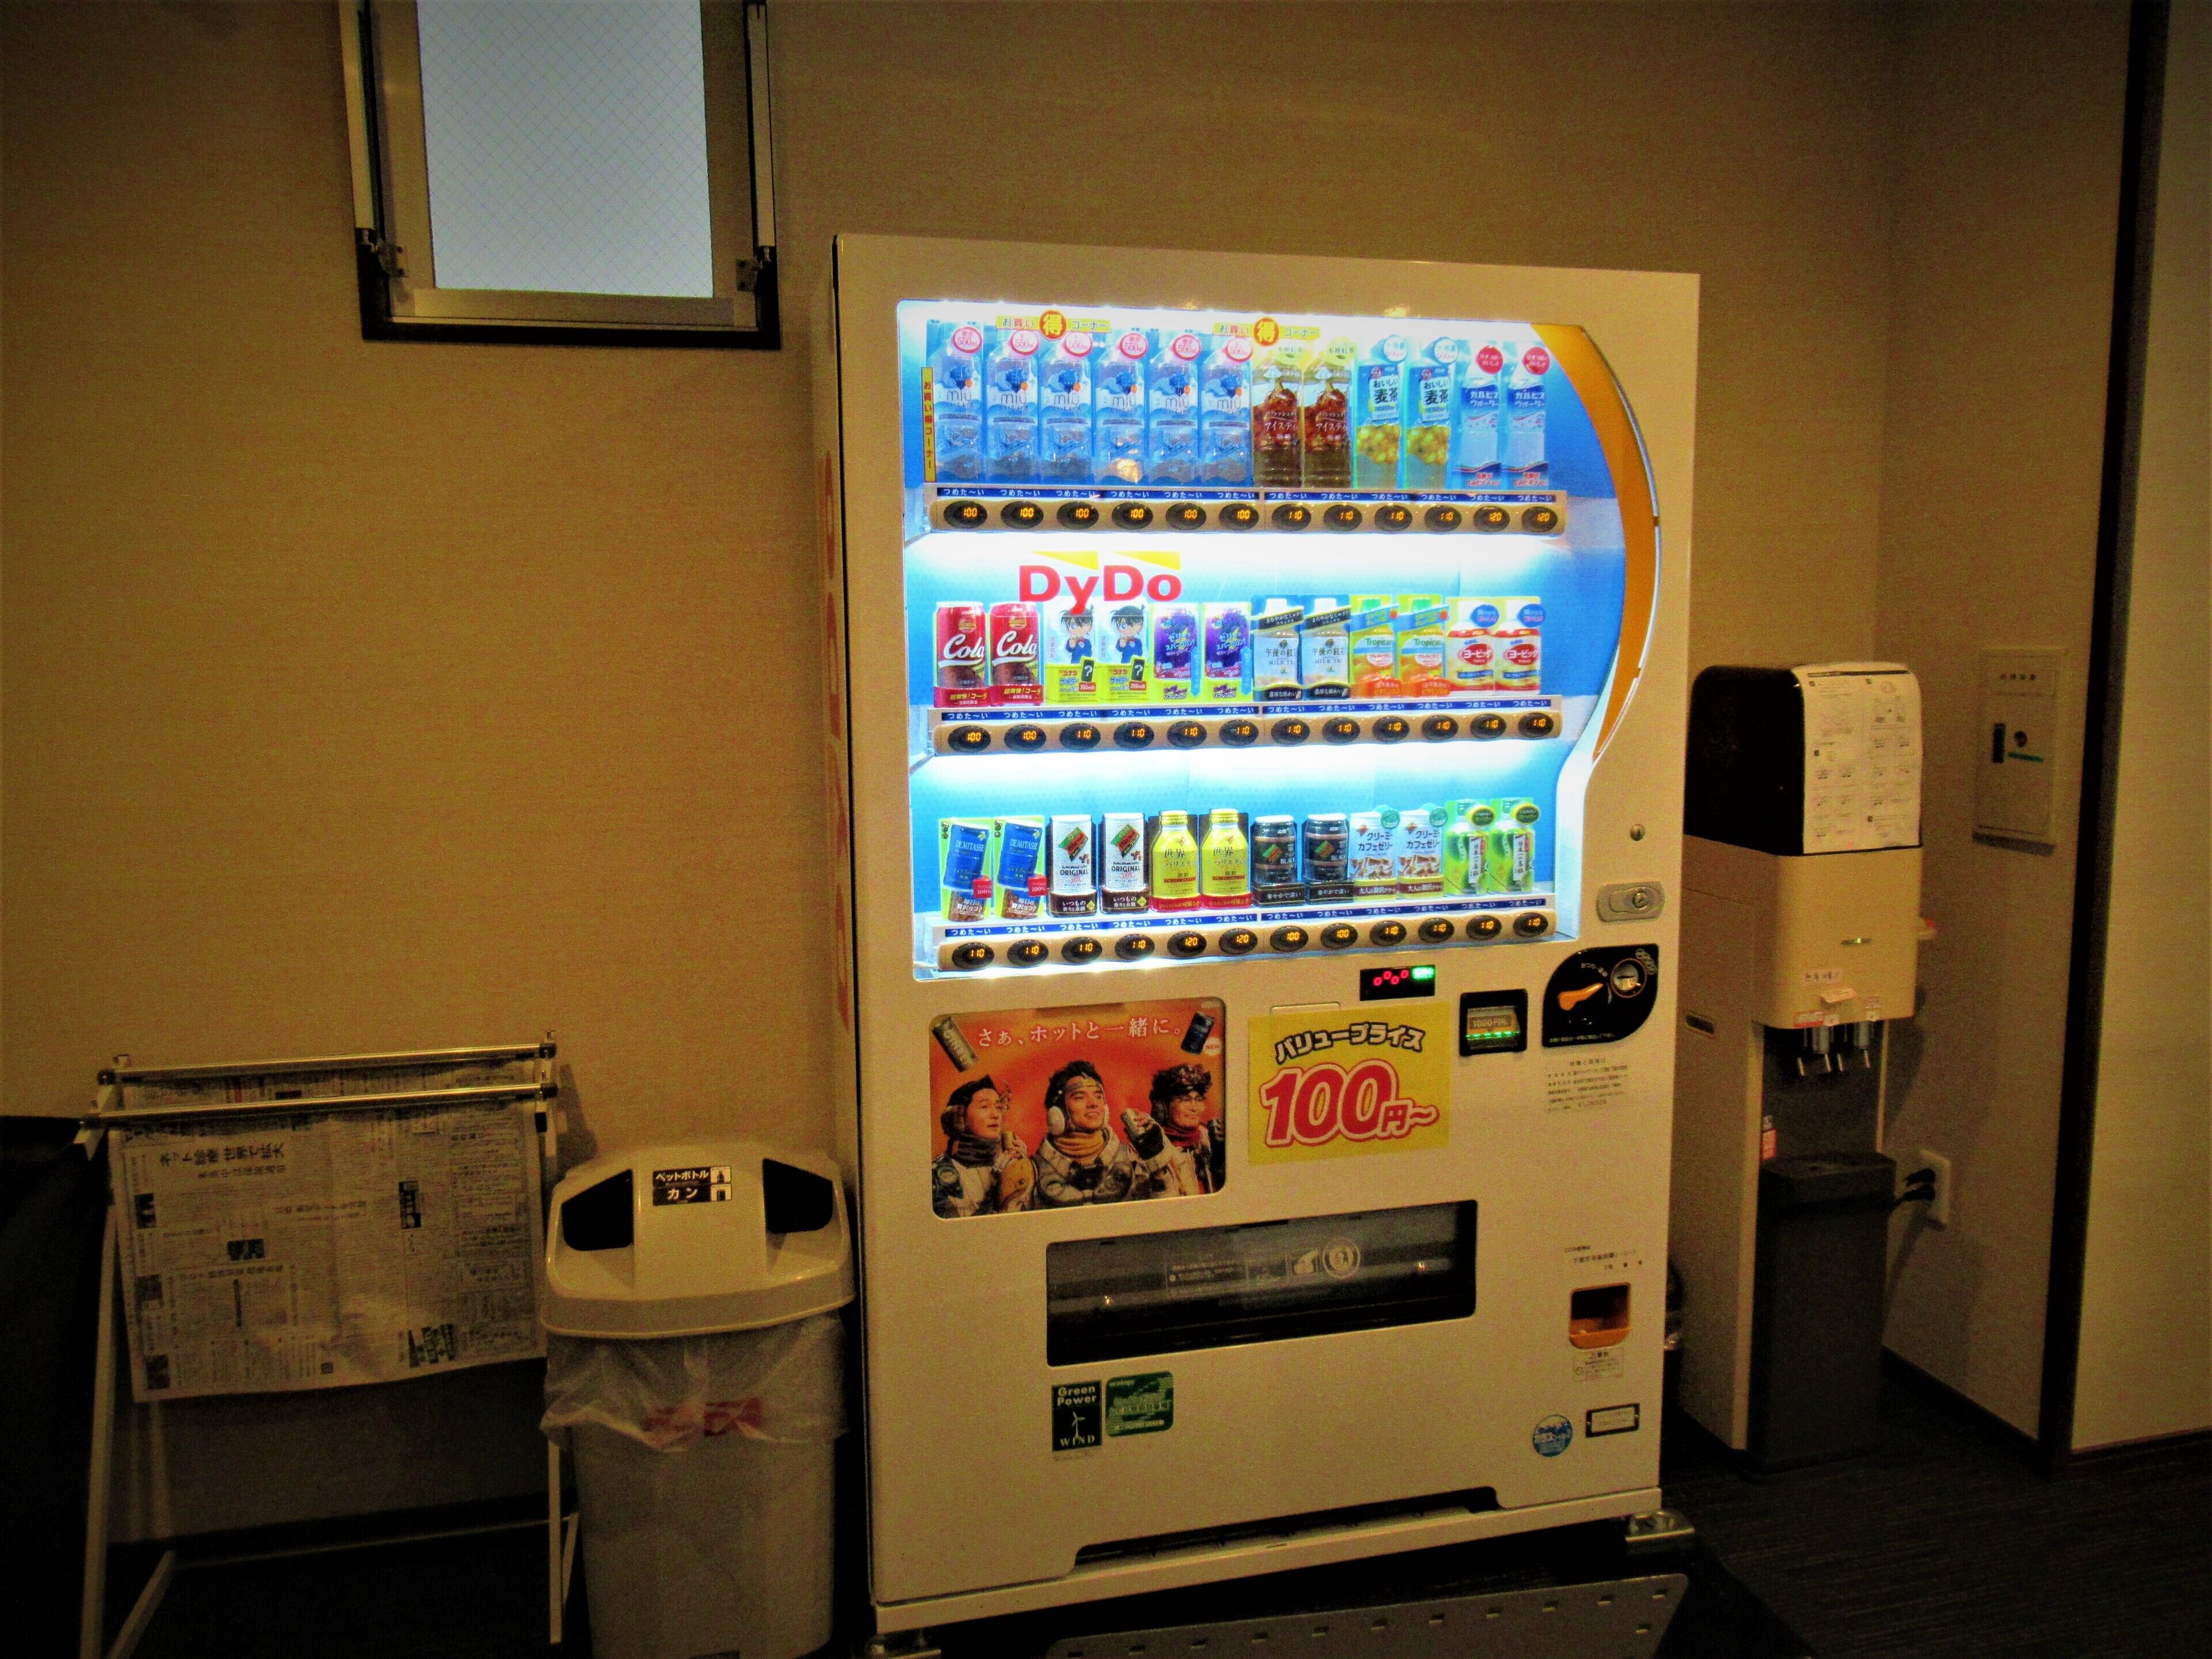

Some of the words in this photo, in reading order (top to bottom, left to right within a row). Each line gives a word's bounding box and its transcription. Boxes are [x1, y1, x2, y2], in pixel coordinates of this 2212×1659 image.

[964, 507, 978, 517] 100
[1020, 507, 1034, 517] 100
[1075, 508, 1089, 518] 100
[1130, 509, 1144, 518] 100
[1184, 509, 1198, 518] 100
[1237, 510, 1250, 519] 100
[1289, 511, 1303, 520] 110
[1340, 511, 1354, 520] 110
[1391, 511, 1404, 521] 110
[1019, 565, 1182, 615] DyDo
[944, 634, 984, 659] Cola
[997, 630, 1037, 657] Cola
[1266, 648, 1296, 657] 午後の紅
[1312, 647, 1344, 656] 午後の紅
[1084, 665, 1092, 677] ?
[1134, 665, 1143, 676] ?
[1236, 726, 1249, 735] 110
[1287, 725, 1302, 734] 110
[1338, 724, 1353, 733] 110
[1388, 722, 1402, 731] 110
[1023, 731, 1037, 740] 100
[1077, 729, 1092, 738] 110
[1131, 728, 1145, 737] 110
[1184, 727, 1198, 736] 110
[967, 732, 981, 741] 100
[955, 840, 984, 852] DEMITASSE
[1010, 838, 1039, 850] DEMITASSE
[1358, 842, 1392, 851] カフェゼリー
[1407, 839, 1440, 849] カフェゼリー
[1336, 929, 1349, 938] 100
[1385, 926, 1399, 935] 110
[1236, 934, 1249, 944] 120
[1287, 932, 1300, 941] 100
[1132, 940, 1146, 949] 110
[1185, 937, 1198, 946] 120
[1025, 946, 1039, 955] 110
[1080, 942, 1093, 952] 110
[971, 949, 984, 957] 110
[1275, 1021, 1426, 1065] バリュープライス
[656, 1170, 709, 1181] ペットボトル
[668, 1188, 698, 1200] カン
[1058, 1386, 1096, 1397] Green
[1057, 1395, 1097, 1407] Power
[1060, 1434, 1095, 1446] WIND
